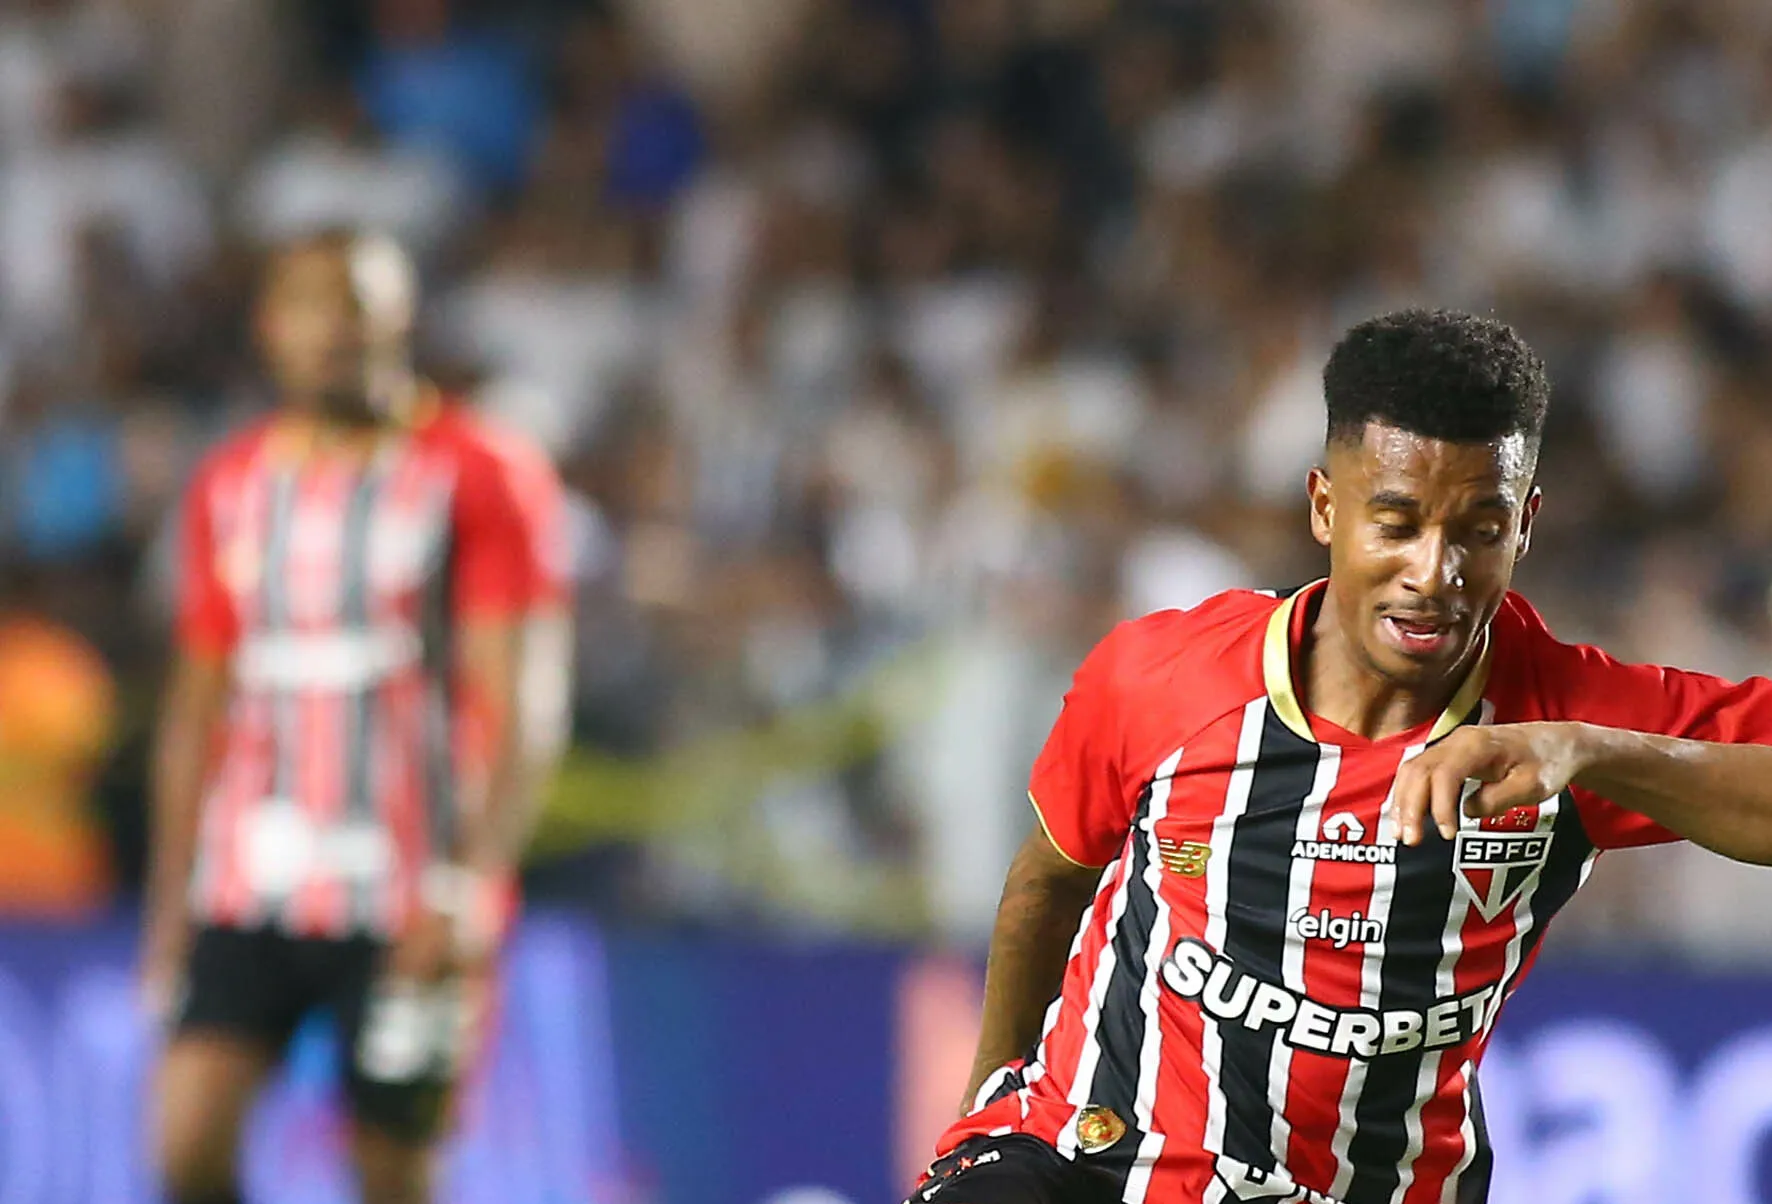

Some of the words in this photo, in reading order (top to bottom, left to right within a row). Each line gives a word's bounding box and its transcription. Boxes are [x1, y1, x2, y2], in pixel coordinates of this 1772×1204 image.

[1291, 841, 1396, 864] ADEMICON
[1463, 840, 1542, 861] SPFC
[1298, 909, 1383, 949] elgin
[1162, 938, 1496, 1058] SUPERBET
